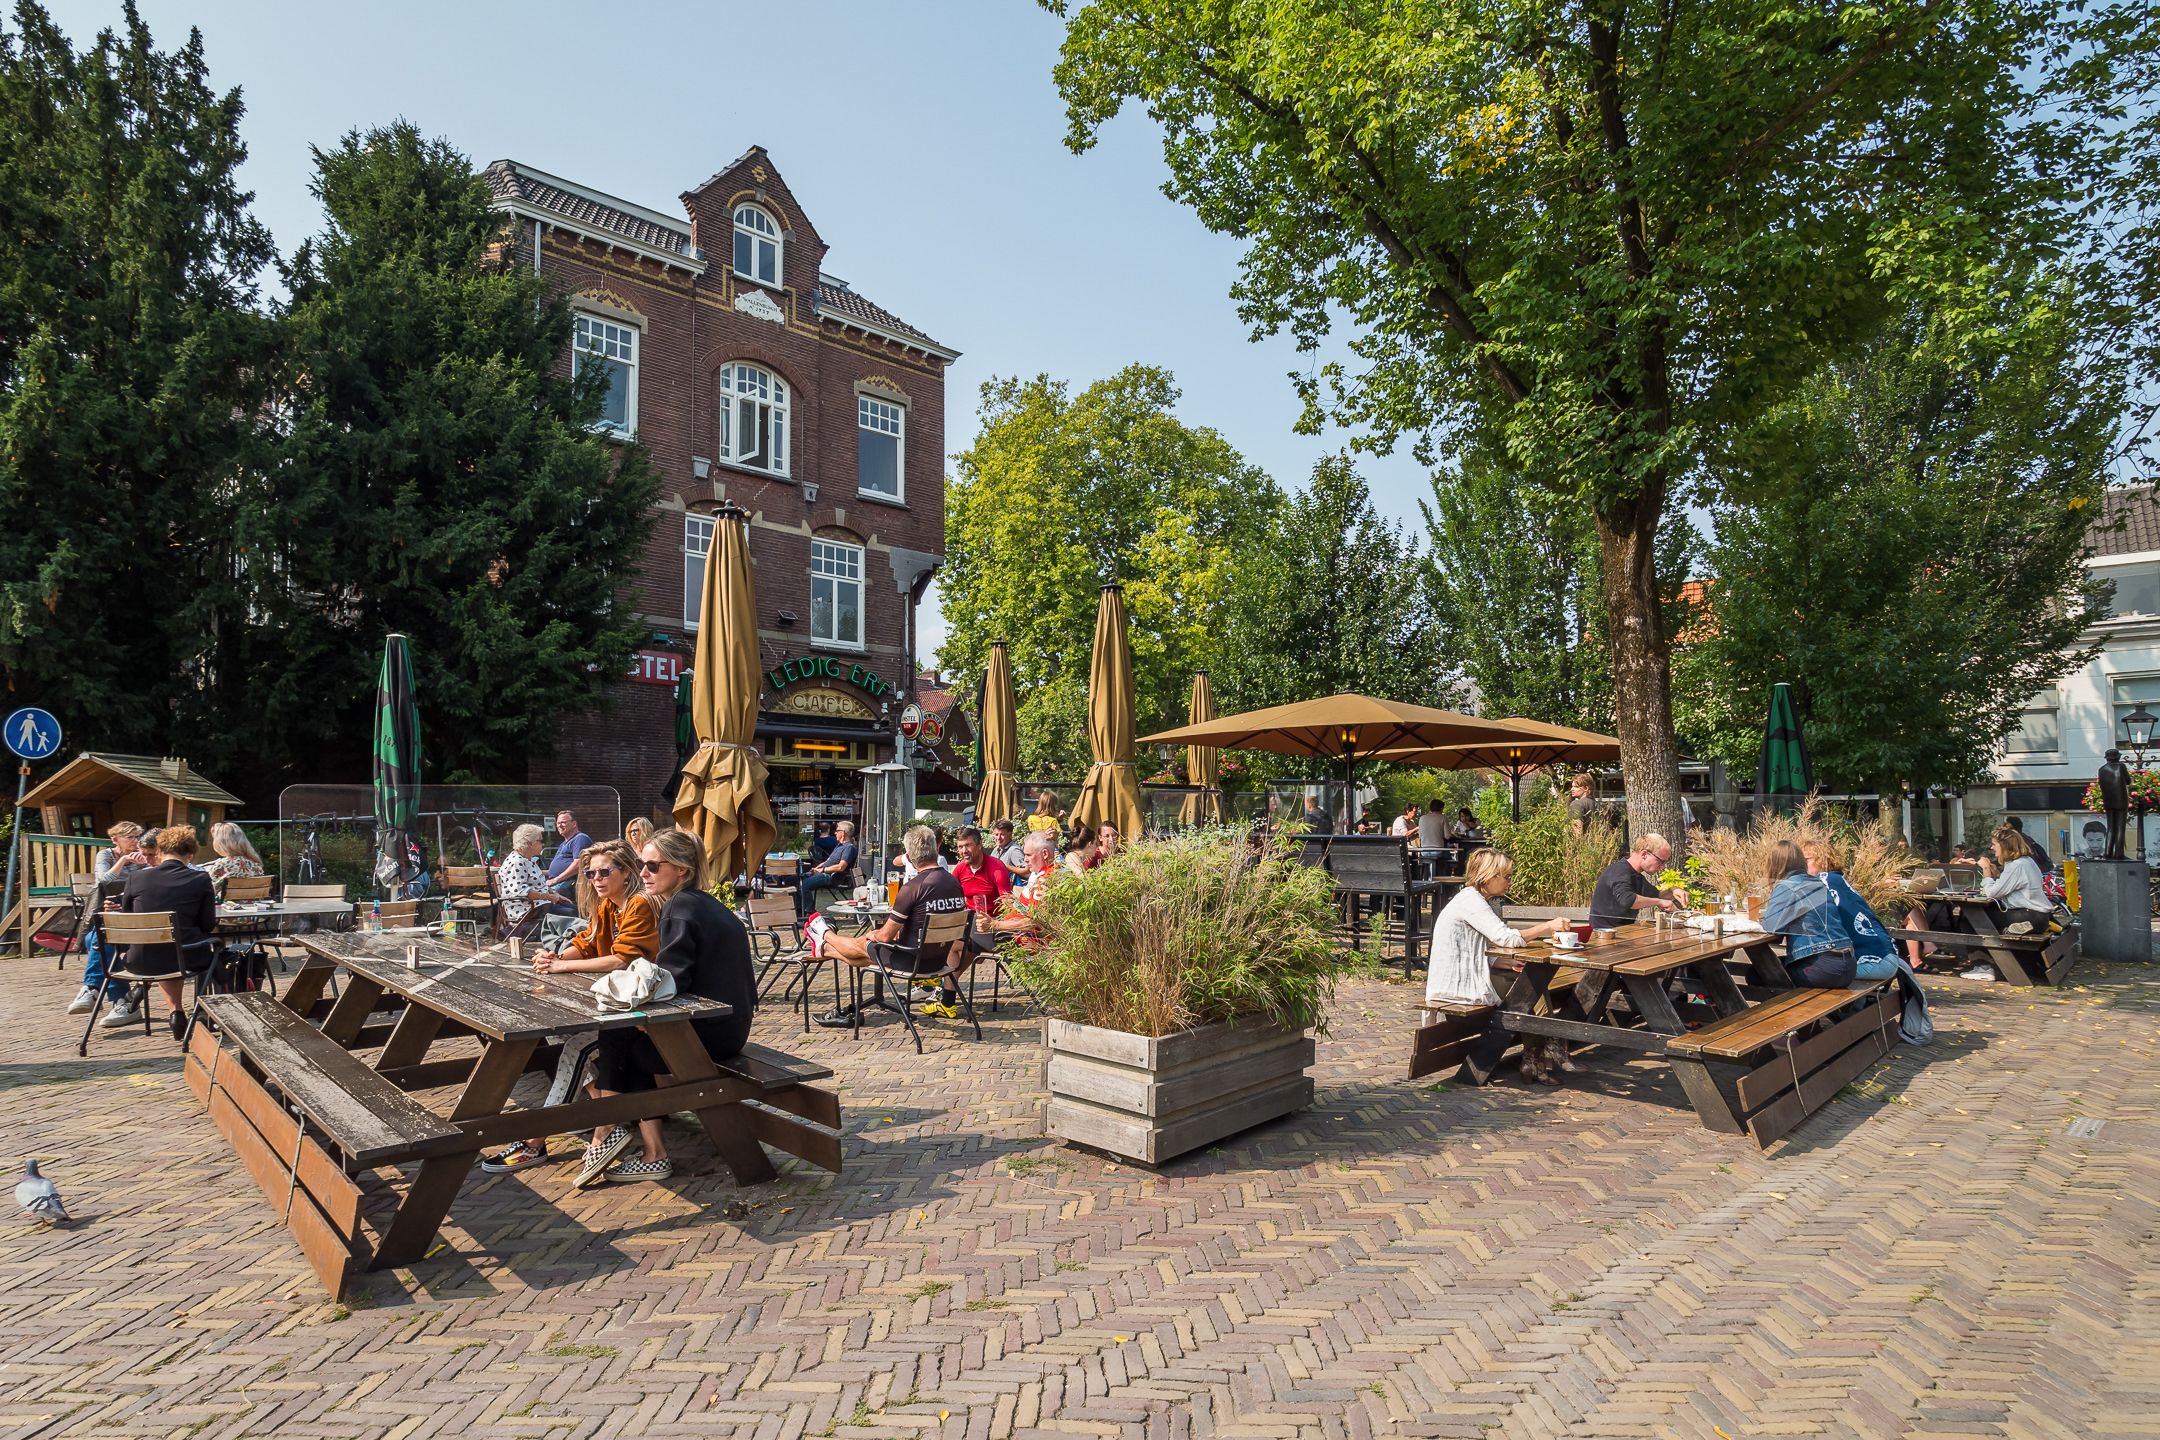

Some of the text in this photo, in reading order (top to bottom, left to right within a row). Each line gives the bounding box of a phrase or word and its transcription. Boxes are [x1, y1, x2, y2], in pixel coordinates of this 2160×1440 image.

[769, 656, 891, 696] LEDIG ERF
[793, 695, 852, 712] CAFE
